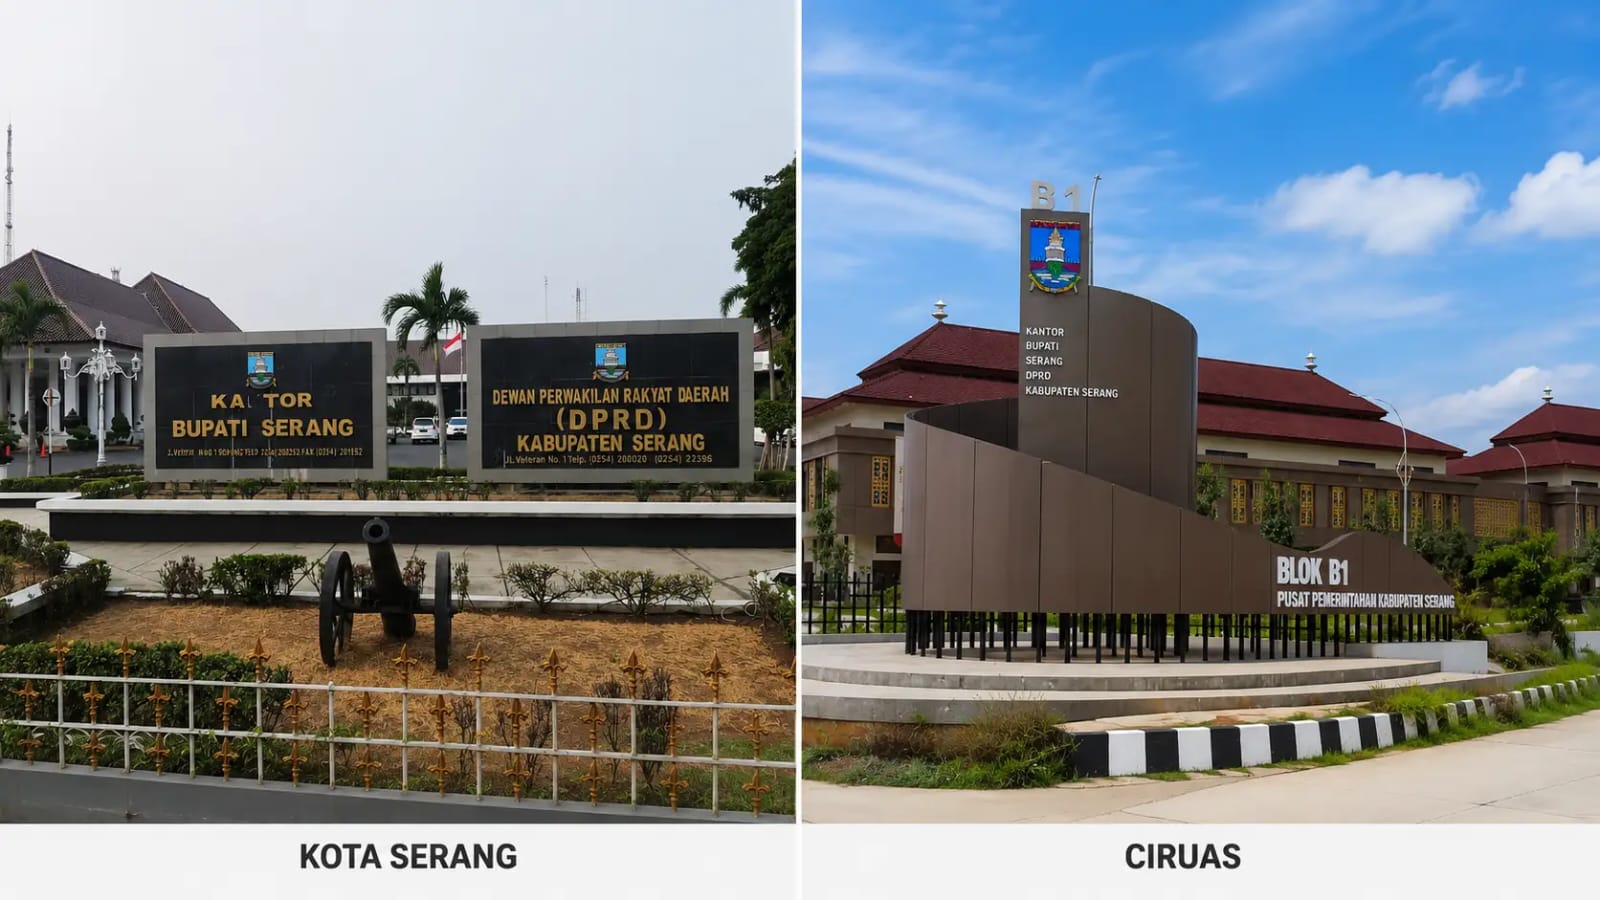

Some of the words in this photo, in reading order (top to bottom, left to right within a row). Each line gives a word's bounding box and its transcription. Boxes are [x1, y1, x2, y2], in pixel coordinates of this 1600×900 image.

[1026, 327, 1064, 337] KANTOR
[1026, 341, 1059, 351] BUPATI
[1026, 356, 1063, 366] SERANG
[1026, 371, 1051, 381] DPRD
[492, 388, 535, 405] DEWAN
[539, 387, 619, 404] PERWAKILAN
[623, 386, 672, 403] RAKYAT
[678, 386, 729, 402] DAERAH
[1026, 386, 1079, 397] KABUPATEN
[1082, 387, 1119, 398] SERANG
[172, 419, 248, 438] BUPATI
[261, 418, 354, 437] SERANG
[556, 407, 667, 431] (DPRD)
[517, 434, 622, 452] KABUPATEN
[632, 433, 705, 451] SERANG
[1277, 556, 1323, 585] BLOK
[1328, 558, 1349, 586] B1
[1277, 591, 1310, 608] PUSAT
[1312, 592, 1377, 608] PEMERINTAHAN
[1378, 593, 1423, 609] KABUPATEN
[1424, 594, 1455, 609] SERANG
